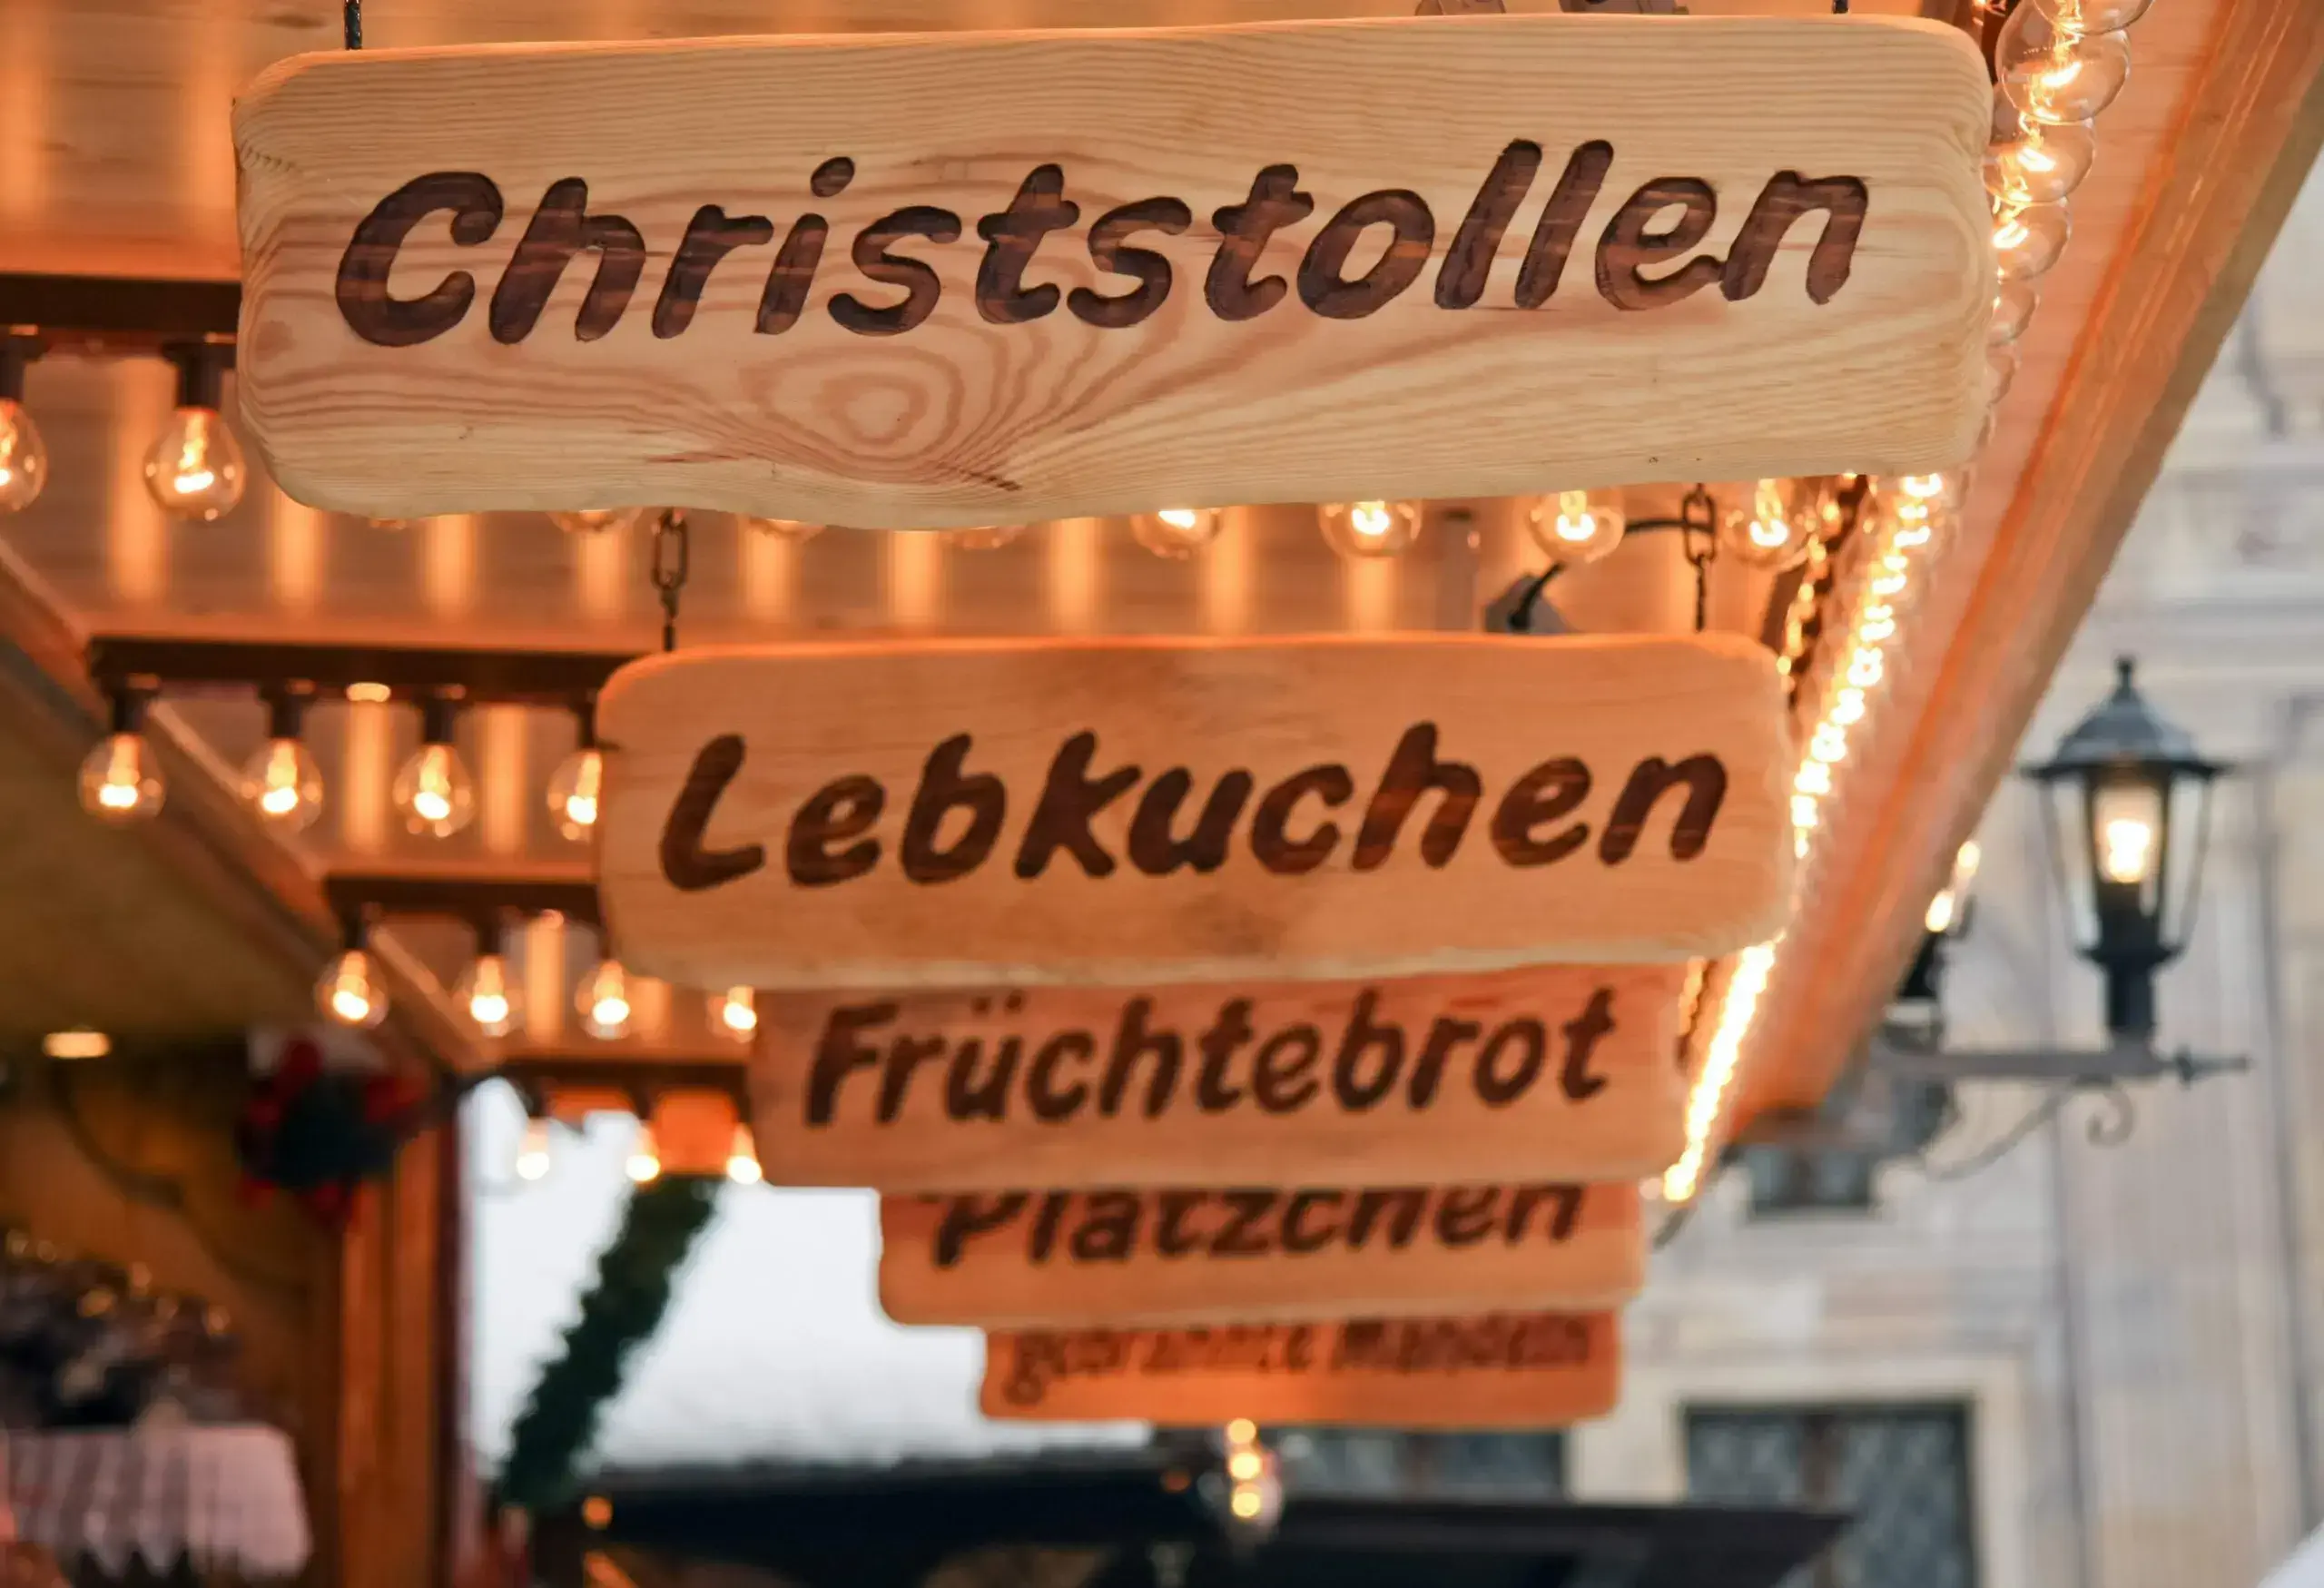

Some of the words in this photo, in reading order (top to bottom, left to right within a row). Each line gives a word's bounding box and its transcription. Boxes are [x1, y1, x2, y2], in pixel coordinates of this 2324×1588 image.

[335, 138, 1871, 349] Christstollen
[658, 721, 1728, 893] Lebkuchen
[801, 985, 1619, 1130] Früchtebrot
